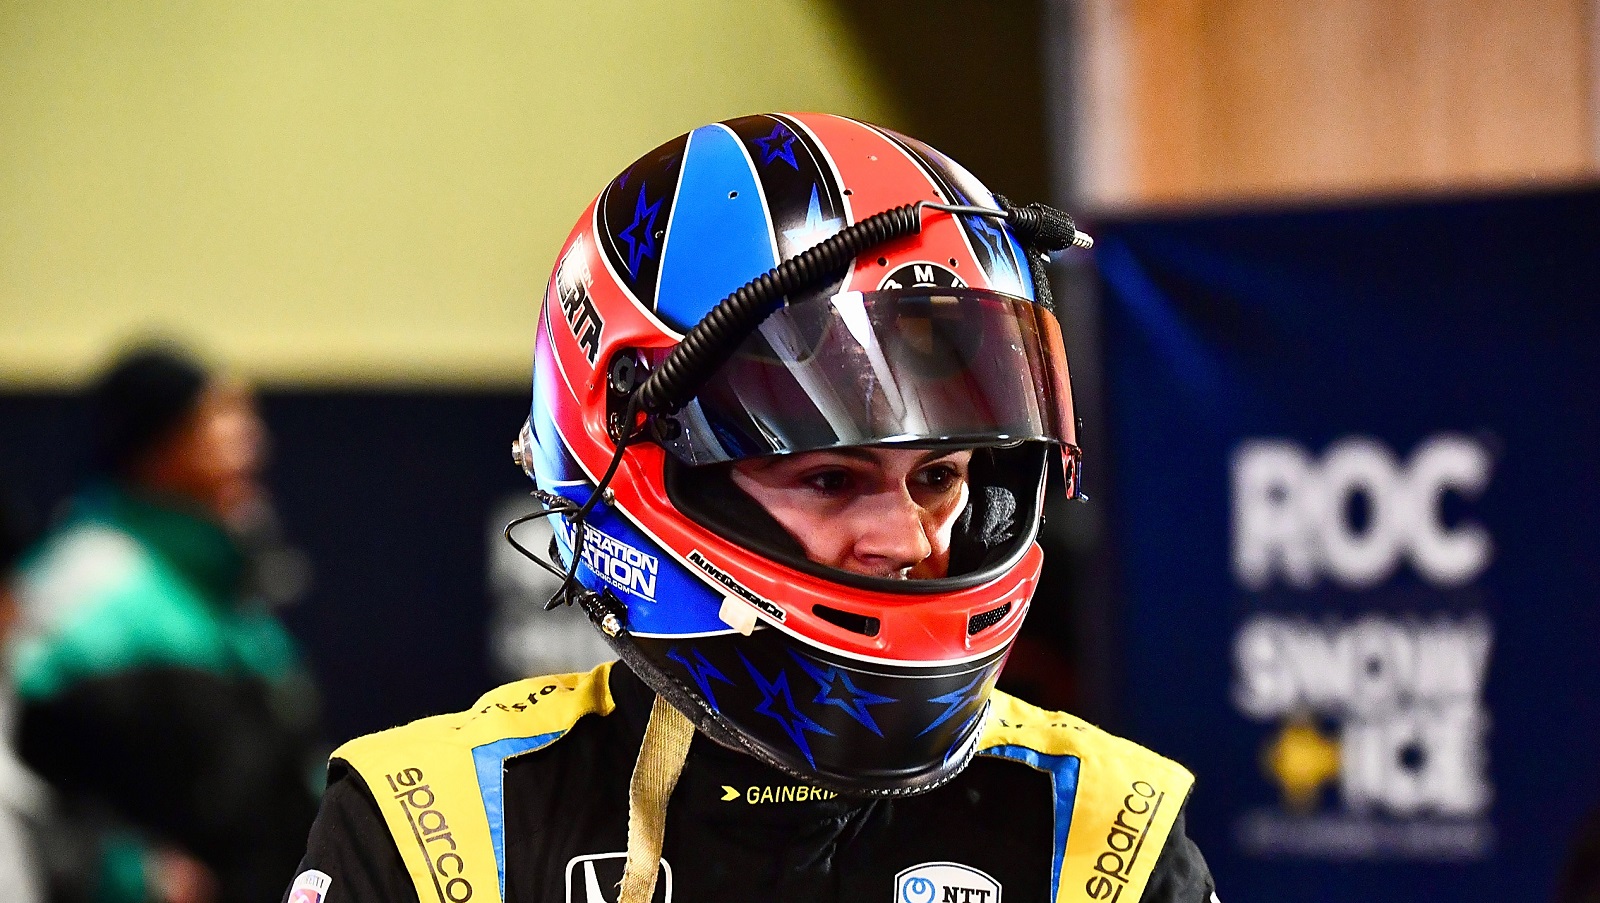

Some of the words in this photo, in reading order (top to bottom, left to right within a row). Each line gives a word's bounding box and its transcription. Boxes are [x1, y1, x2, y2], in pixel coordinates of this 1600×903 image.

[1232, 438, 1491, 586] ROC
[394, 767, 473, 903] sparco
[746, 785, 838, 805] GAINBRI
[1084, 780, 1156, 900] sparco
[942, 885, 991, 903] NTT
